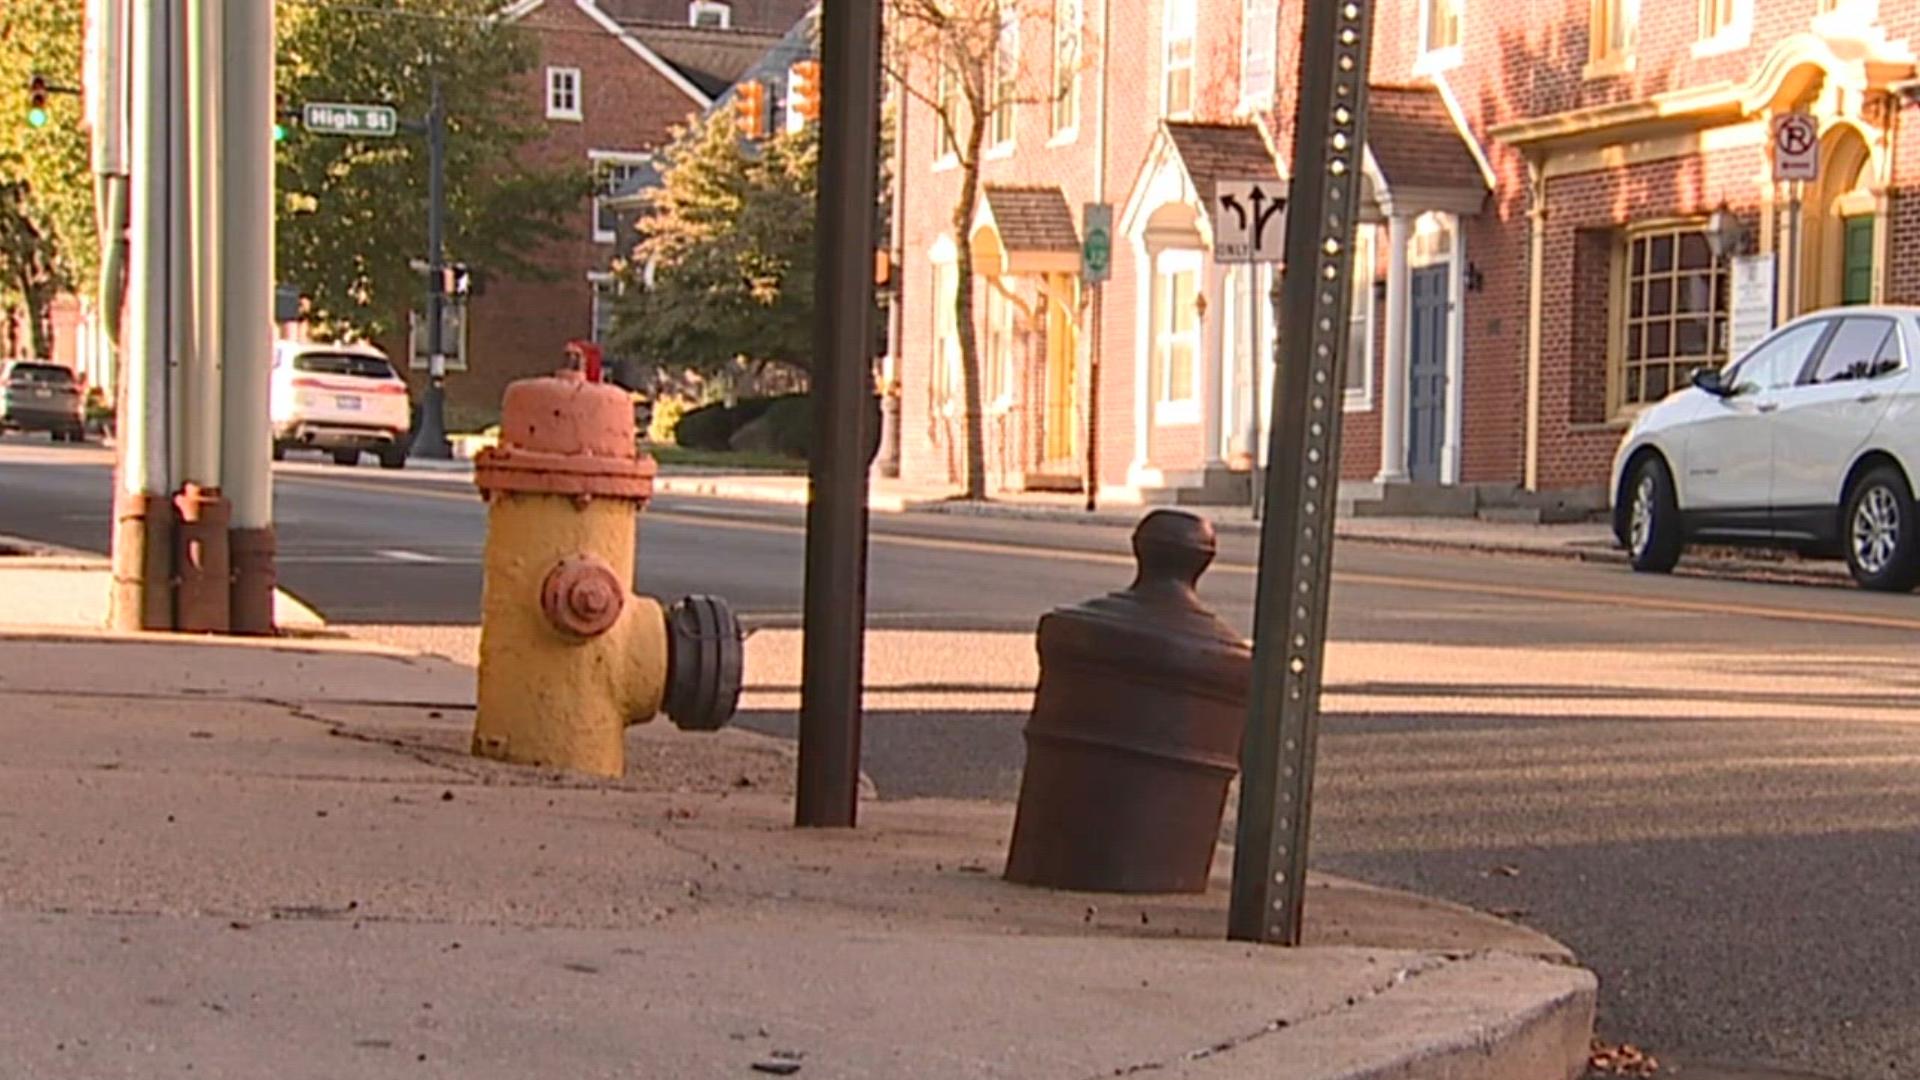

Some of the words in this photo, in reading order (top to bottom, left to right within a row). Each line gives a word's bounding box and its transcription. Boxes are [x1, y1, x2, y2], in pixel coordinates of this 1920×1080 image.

[312, 109, 359, 130] High
[366, 111, 388, 129] St
[1216, 244, 1248, 256] ONLY
